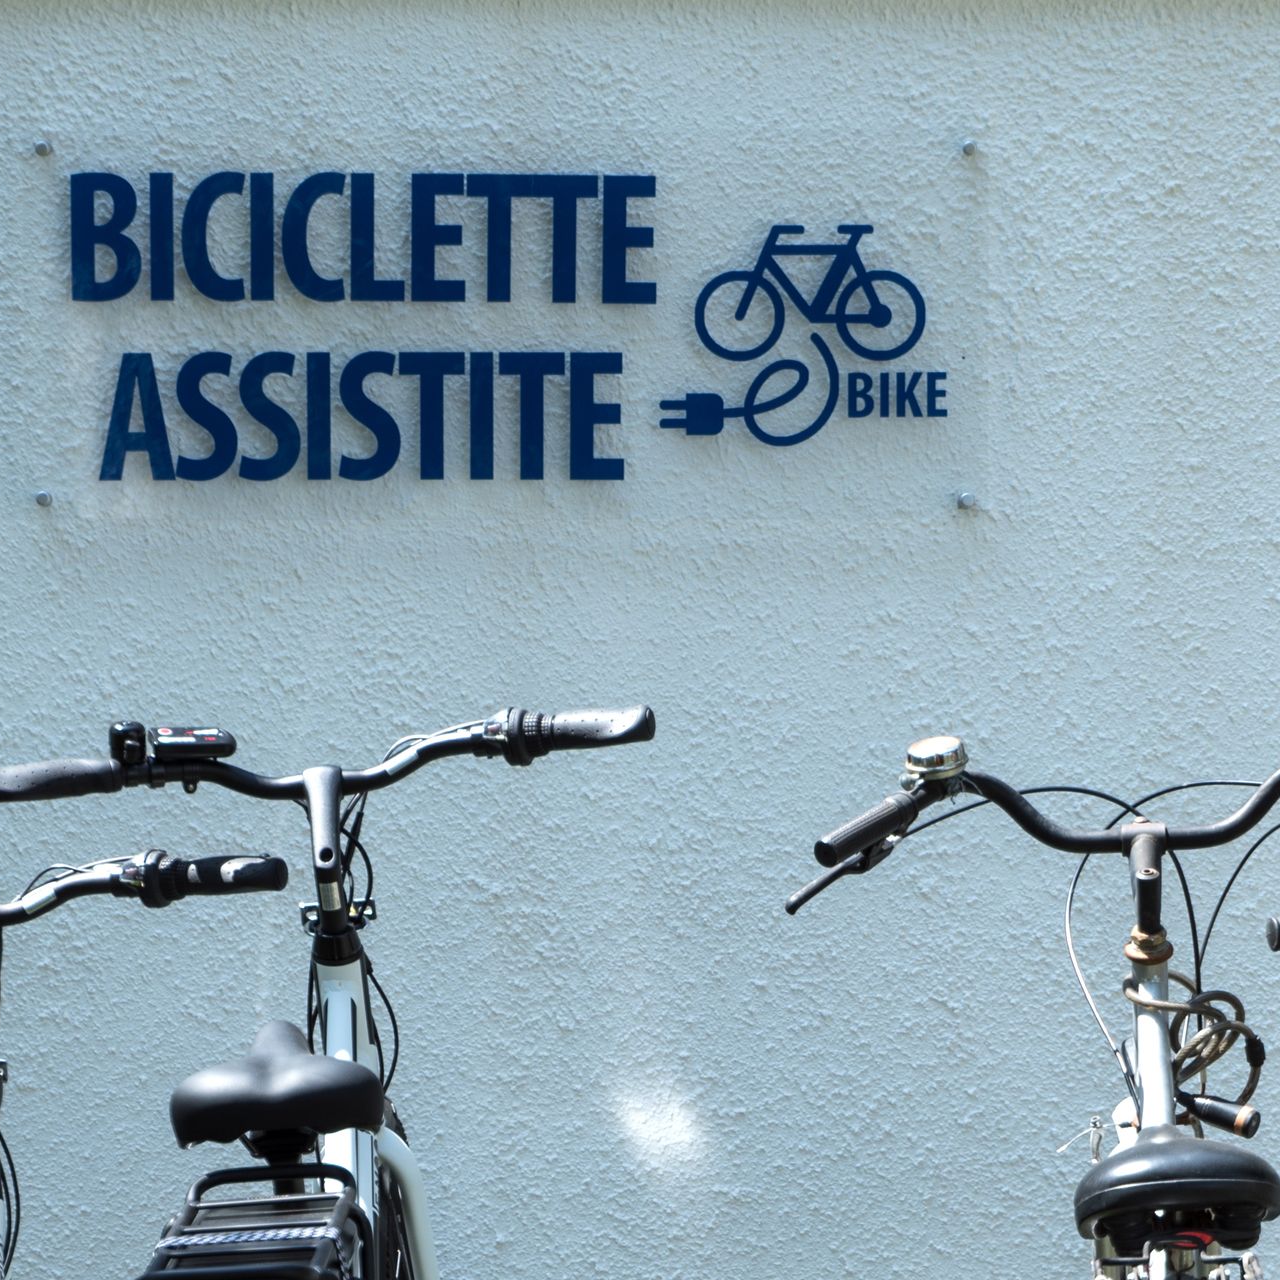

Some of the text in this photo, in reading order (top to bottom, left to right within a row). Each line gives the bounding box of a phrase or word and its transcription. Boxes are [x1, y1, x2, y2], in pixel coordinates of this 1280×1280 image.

[69, 171, 657, 305] BICICLETTE
[99, 351, 625, 482] ASSISTITE
[847, 371, 948, 419] BIKE
